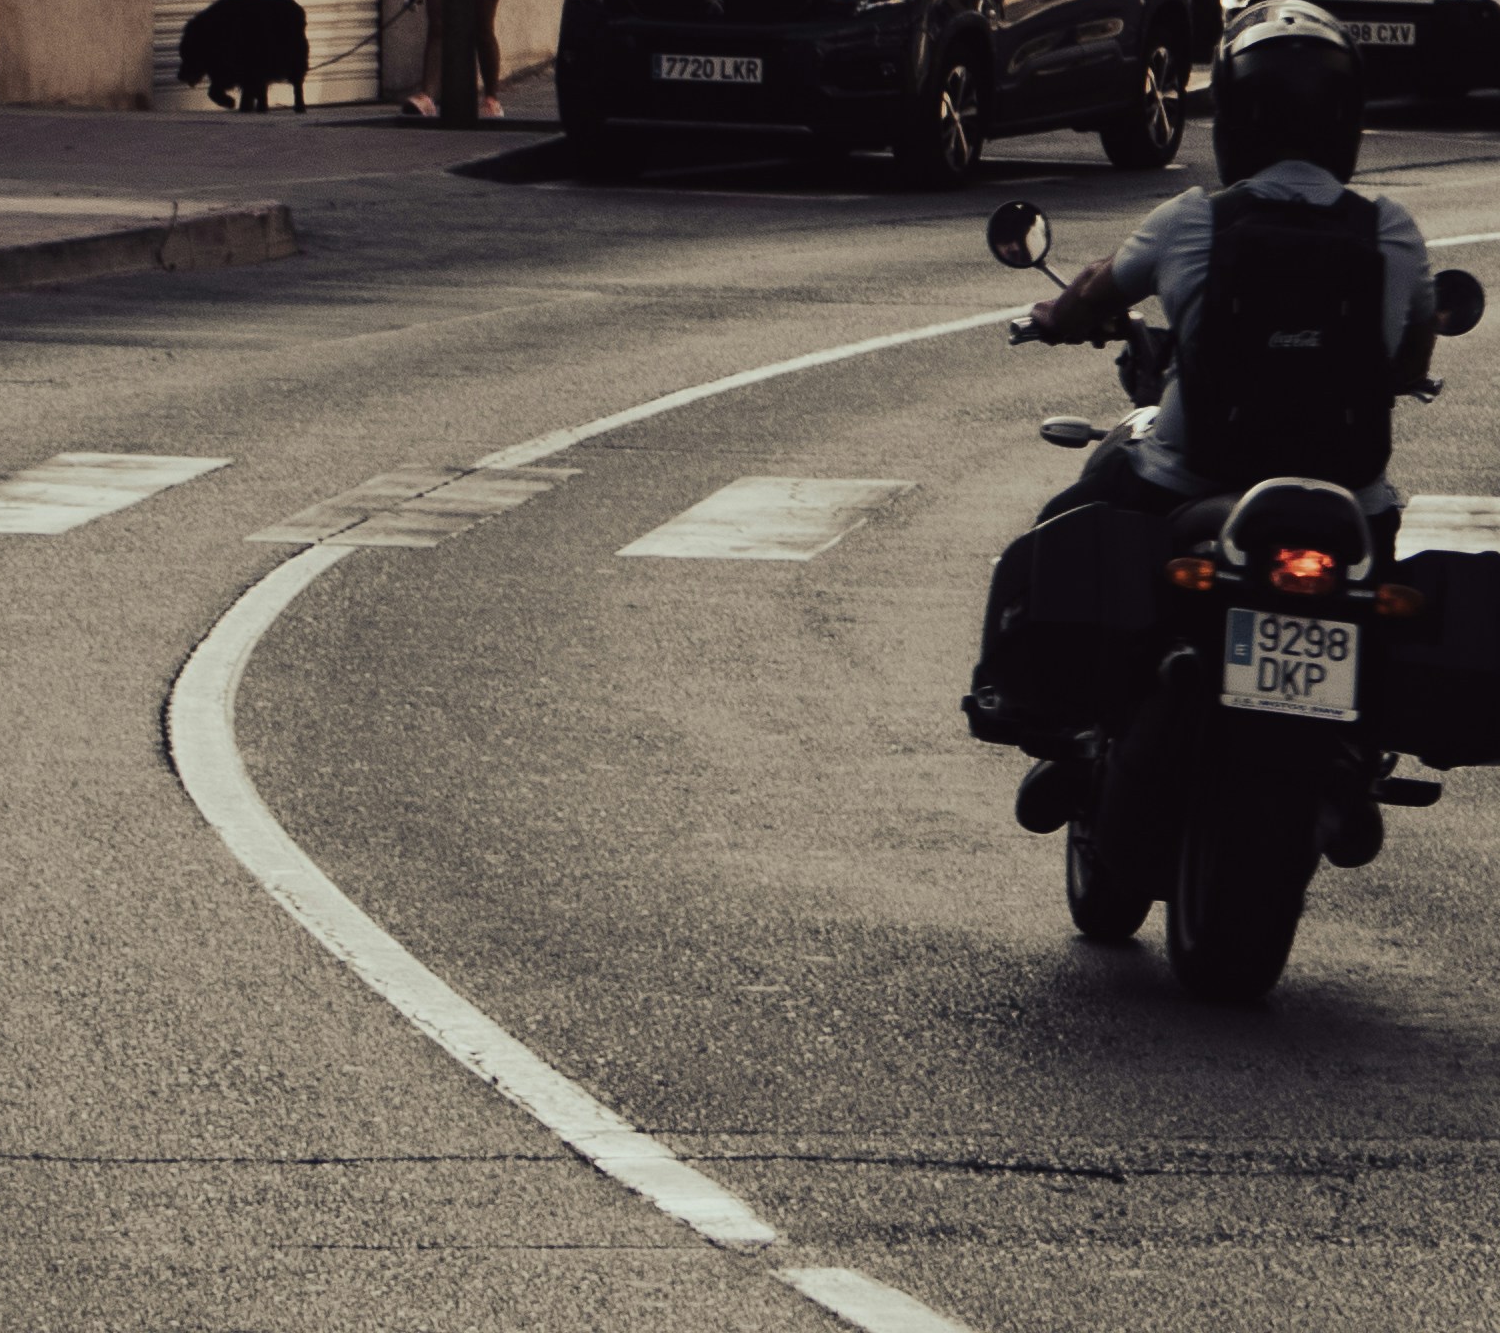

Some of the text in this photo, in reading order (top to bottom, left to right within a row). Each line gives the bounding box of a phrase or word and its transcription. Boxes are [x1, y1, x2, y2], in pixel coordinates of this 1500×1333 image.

[1350, 23, 1411, 43] 98 CXV
[665, 56, 715, 79] 7720
[720, 59, 759, 81] LKR
[1257, 616, 1349, 662] 9298
[1257, 656, 1326, 696] DKP
